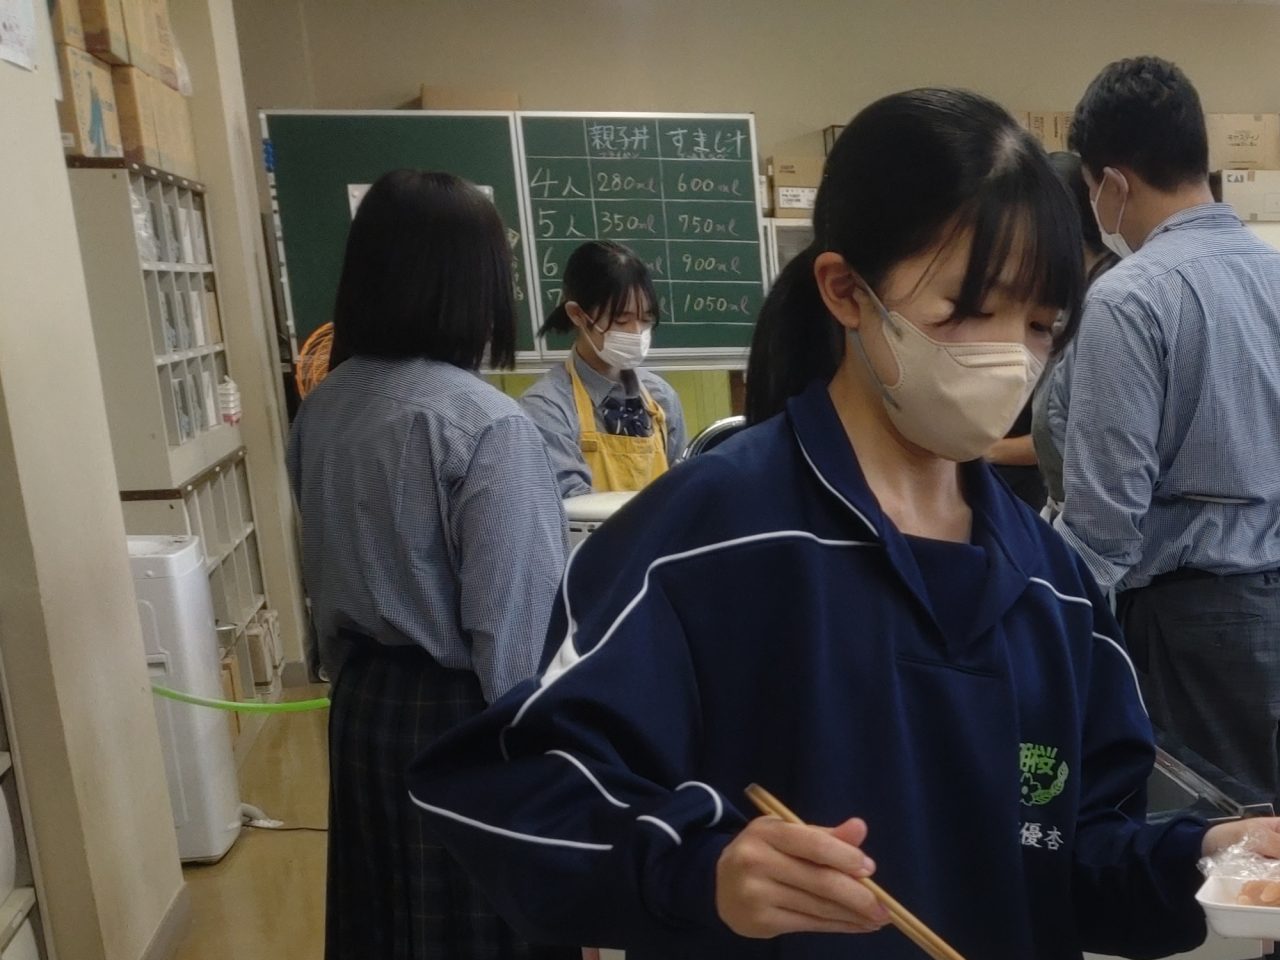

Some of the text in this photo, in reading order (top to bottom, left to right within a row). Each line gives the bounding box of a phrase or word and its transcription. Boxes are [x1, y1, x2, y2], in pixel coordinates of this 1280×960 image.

[666, 127, 747, 158] すまし汁
[537, 210, 586, 238] 5人
